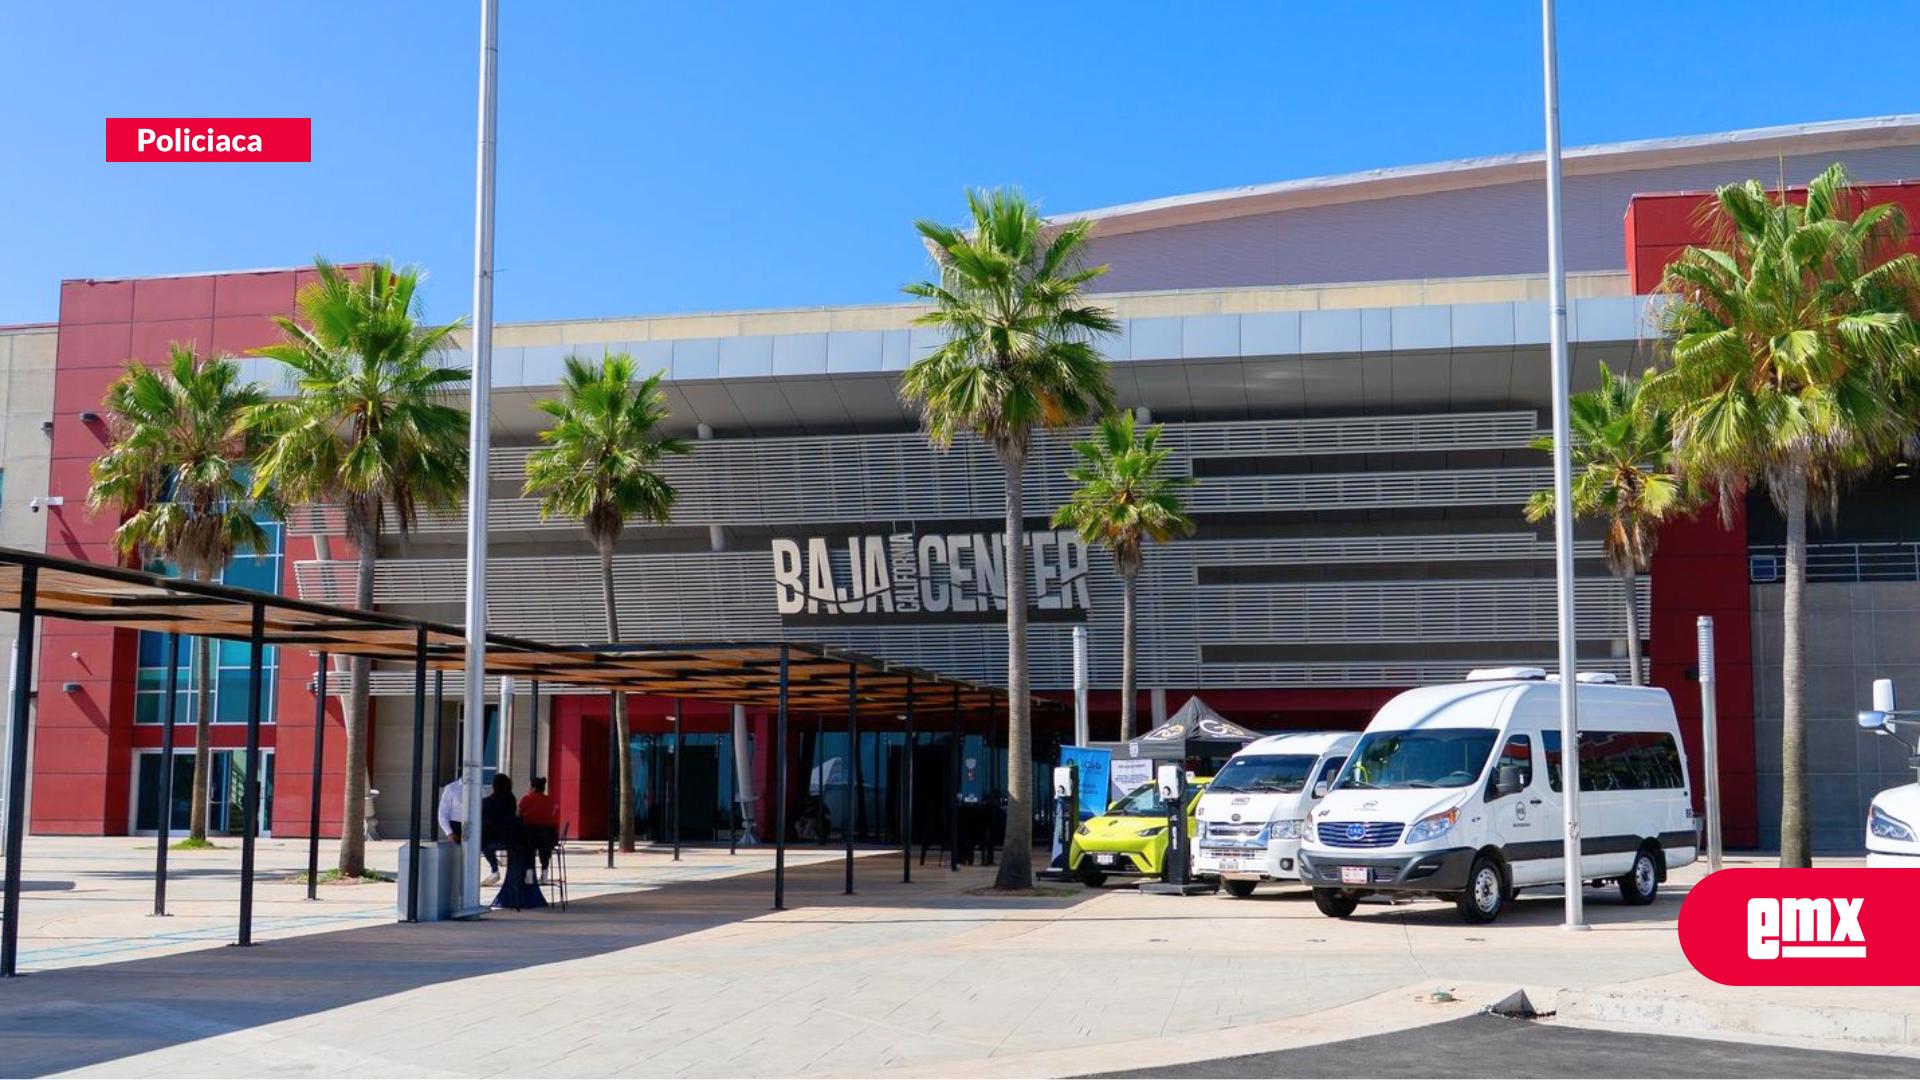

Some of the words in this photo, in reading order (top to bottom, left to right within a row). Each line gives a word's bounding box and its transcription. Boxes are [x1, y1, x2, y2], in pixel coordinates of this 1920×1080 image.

[772, 537, 895, 614] BAJA
[889, 533, 921, 612] CALIFORNIA
[918, 530, 1091, 612] CENER
